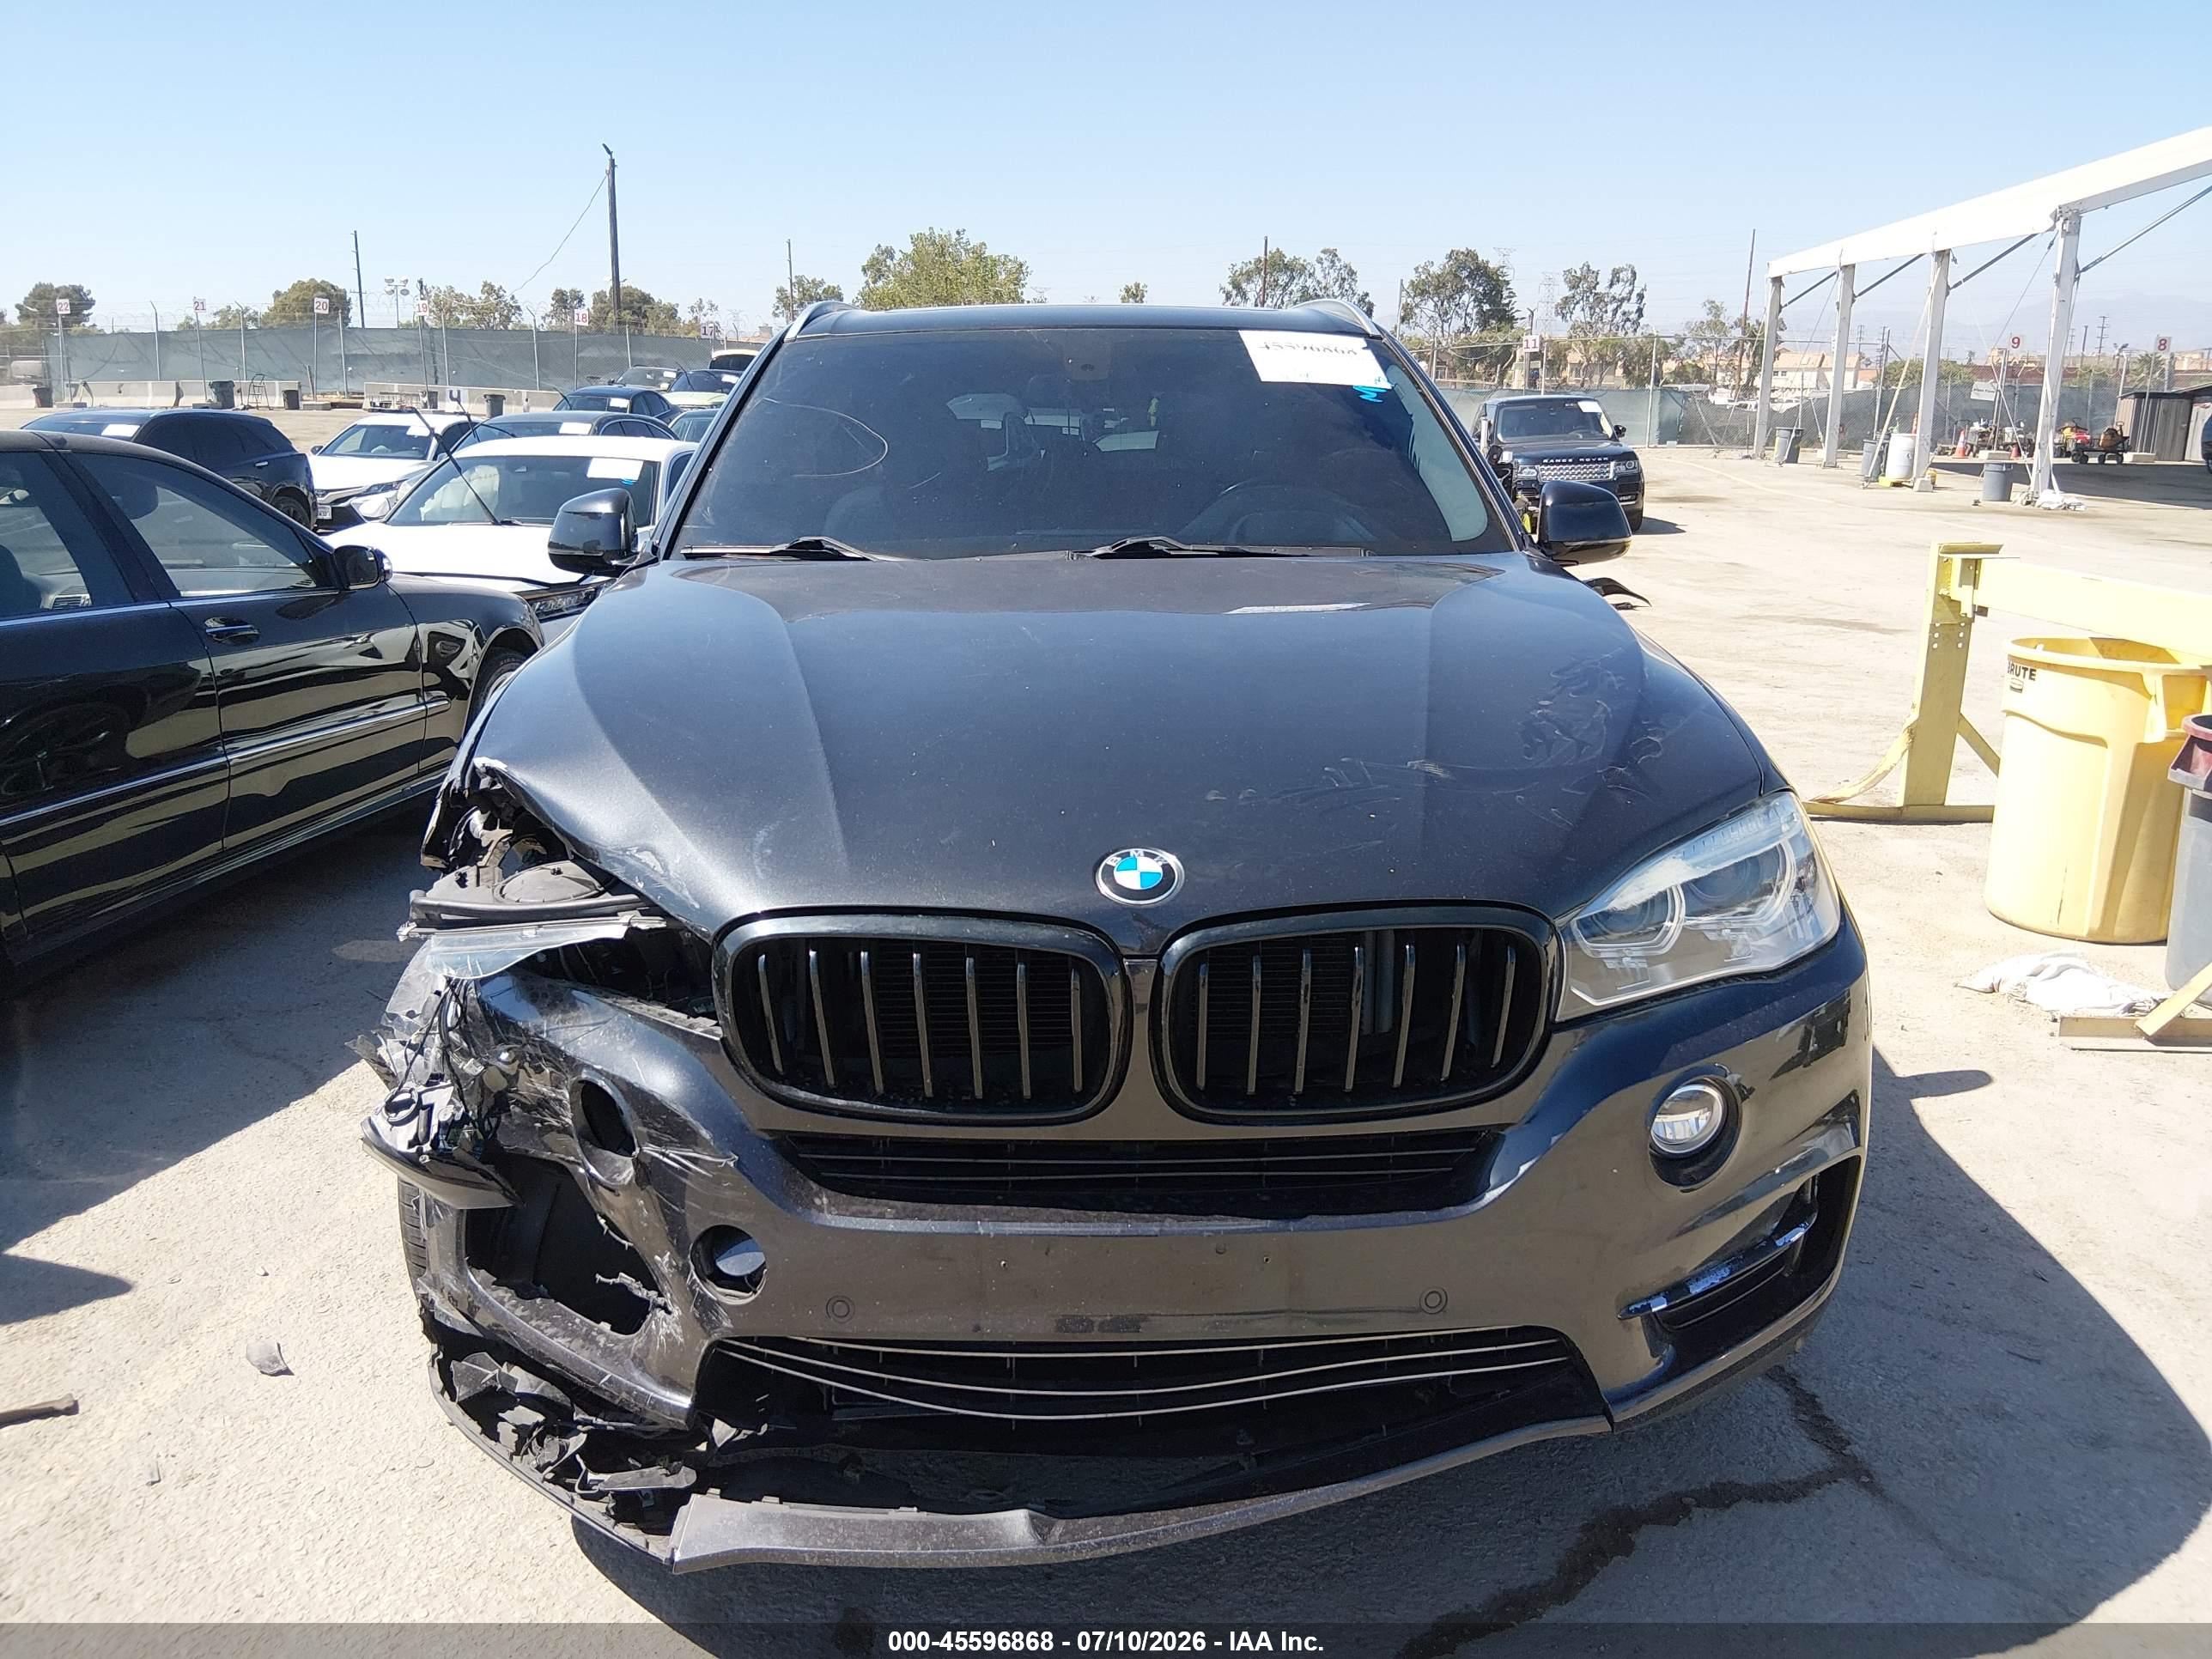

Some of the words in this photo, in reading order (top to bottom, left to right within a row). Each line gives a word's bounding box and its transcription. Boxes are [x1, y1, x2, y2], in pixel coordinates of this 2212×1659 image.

[58, 301, 70, 312] 22
[193, 301, 206, 311] 21
[315, 301, 328, 311] 20
[416, 302, 428, 313] 19
[575, 313, 587, 323] 18
[702, 325, 714, 336] 17
[1524, 338, 1538, 349] 11
[2011, 336, 2021, 349] 9
[2157, 338, 2167, 351] 8
